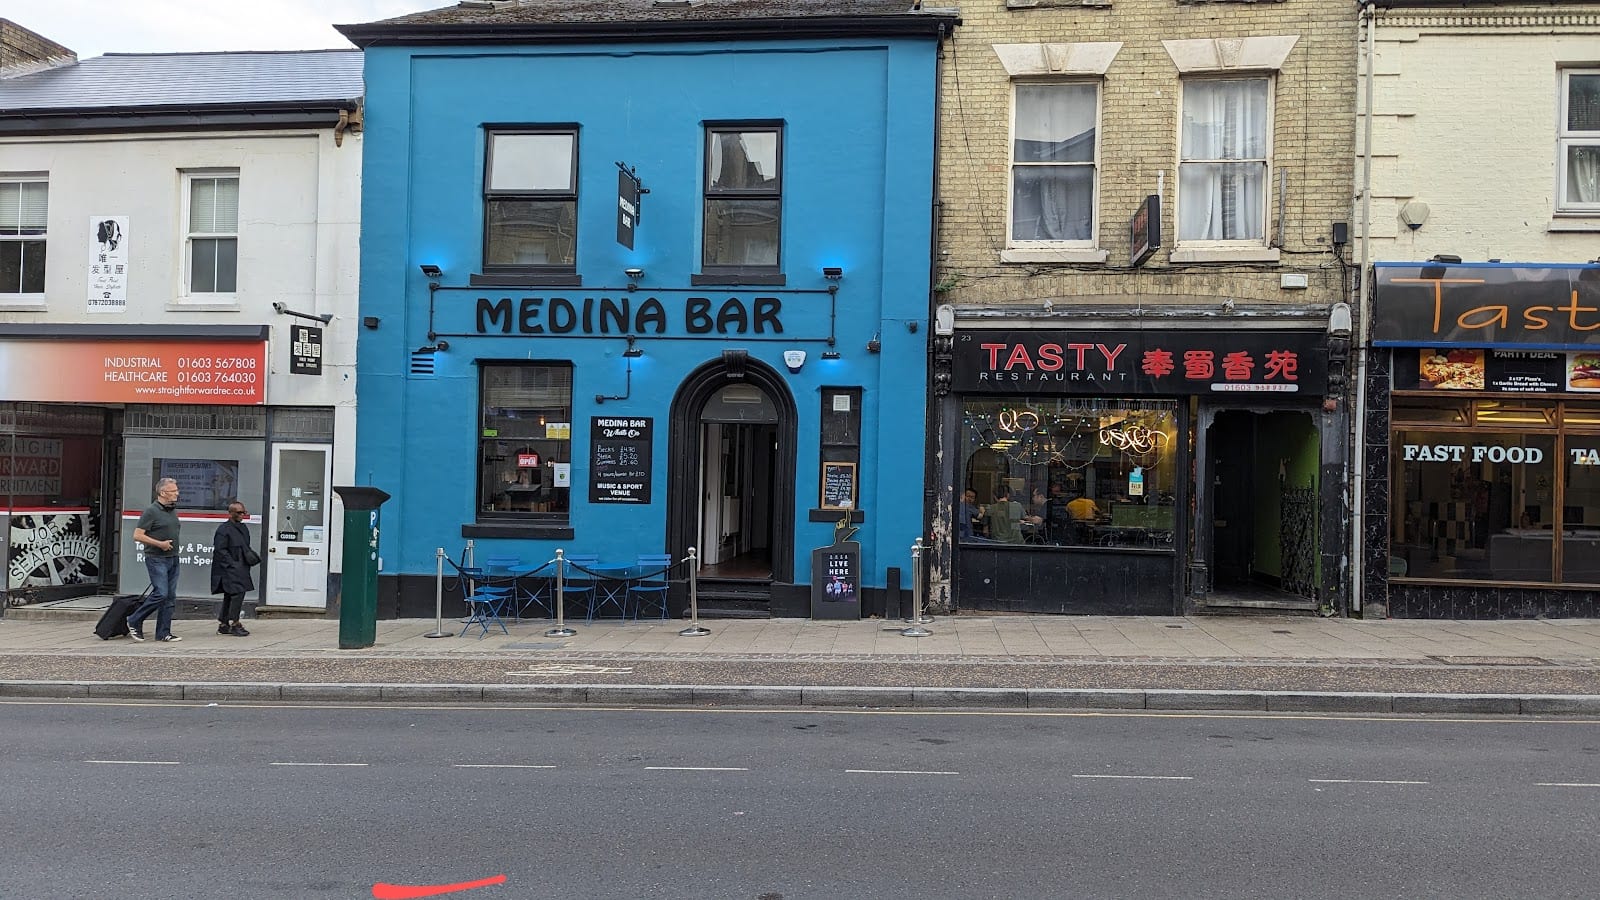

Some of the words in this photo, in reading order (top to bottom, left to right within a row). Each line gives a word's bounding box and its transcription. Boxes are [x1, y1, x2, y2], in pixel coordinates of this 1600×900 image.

[98, 253, 118, 263] 唯一
[1390, 278, 1600, 334] Tast
[476, 297, 666, 334] MEDINA
[685, 297, 783, 334] BAR
[980, 343, 1128, 372] TASTY
[1493, 351, 1527, 359] PARTY
[1529, 351, 1558, 359] DEAL
[104, 357, 161, 368] INDUSTRIAL
[177, 357, 212, 369] 01603
[214, 357, 256, 369] 567808
[104, 371, 168, 382] HEALTHCARE
[177, 372, 212, 383] 01603
[214, 372, 256, 383] 764030
[980, 372, 1128, 381] RESTAURANT
[135, 385, 256, 397] www.straightforwardrec.co.uk
[597, 419, 628, 428] MEDINA
[629, 419, 646, 428] BAR
[1403, 444, 1465, 462] FAST
[1471, 446, 1543, 464] FOOD
[0, 458, 59, 475] RWARD
[291, 487, 314, 498] 唯一
[286, 500, 319, 511] 发型屋
[27, 521, 59, 543] JOB
[186, 543, 194, 553] &
[310, 548, 320, 556] 27
[11, 541, 98, 582] SEARCHING
